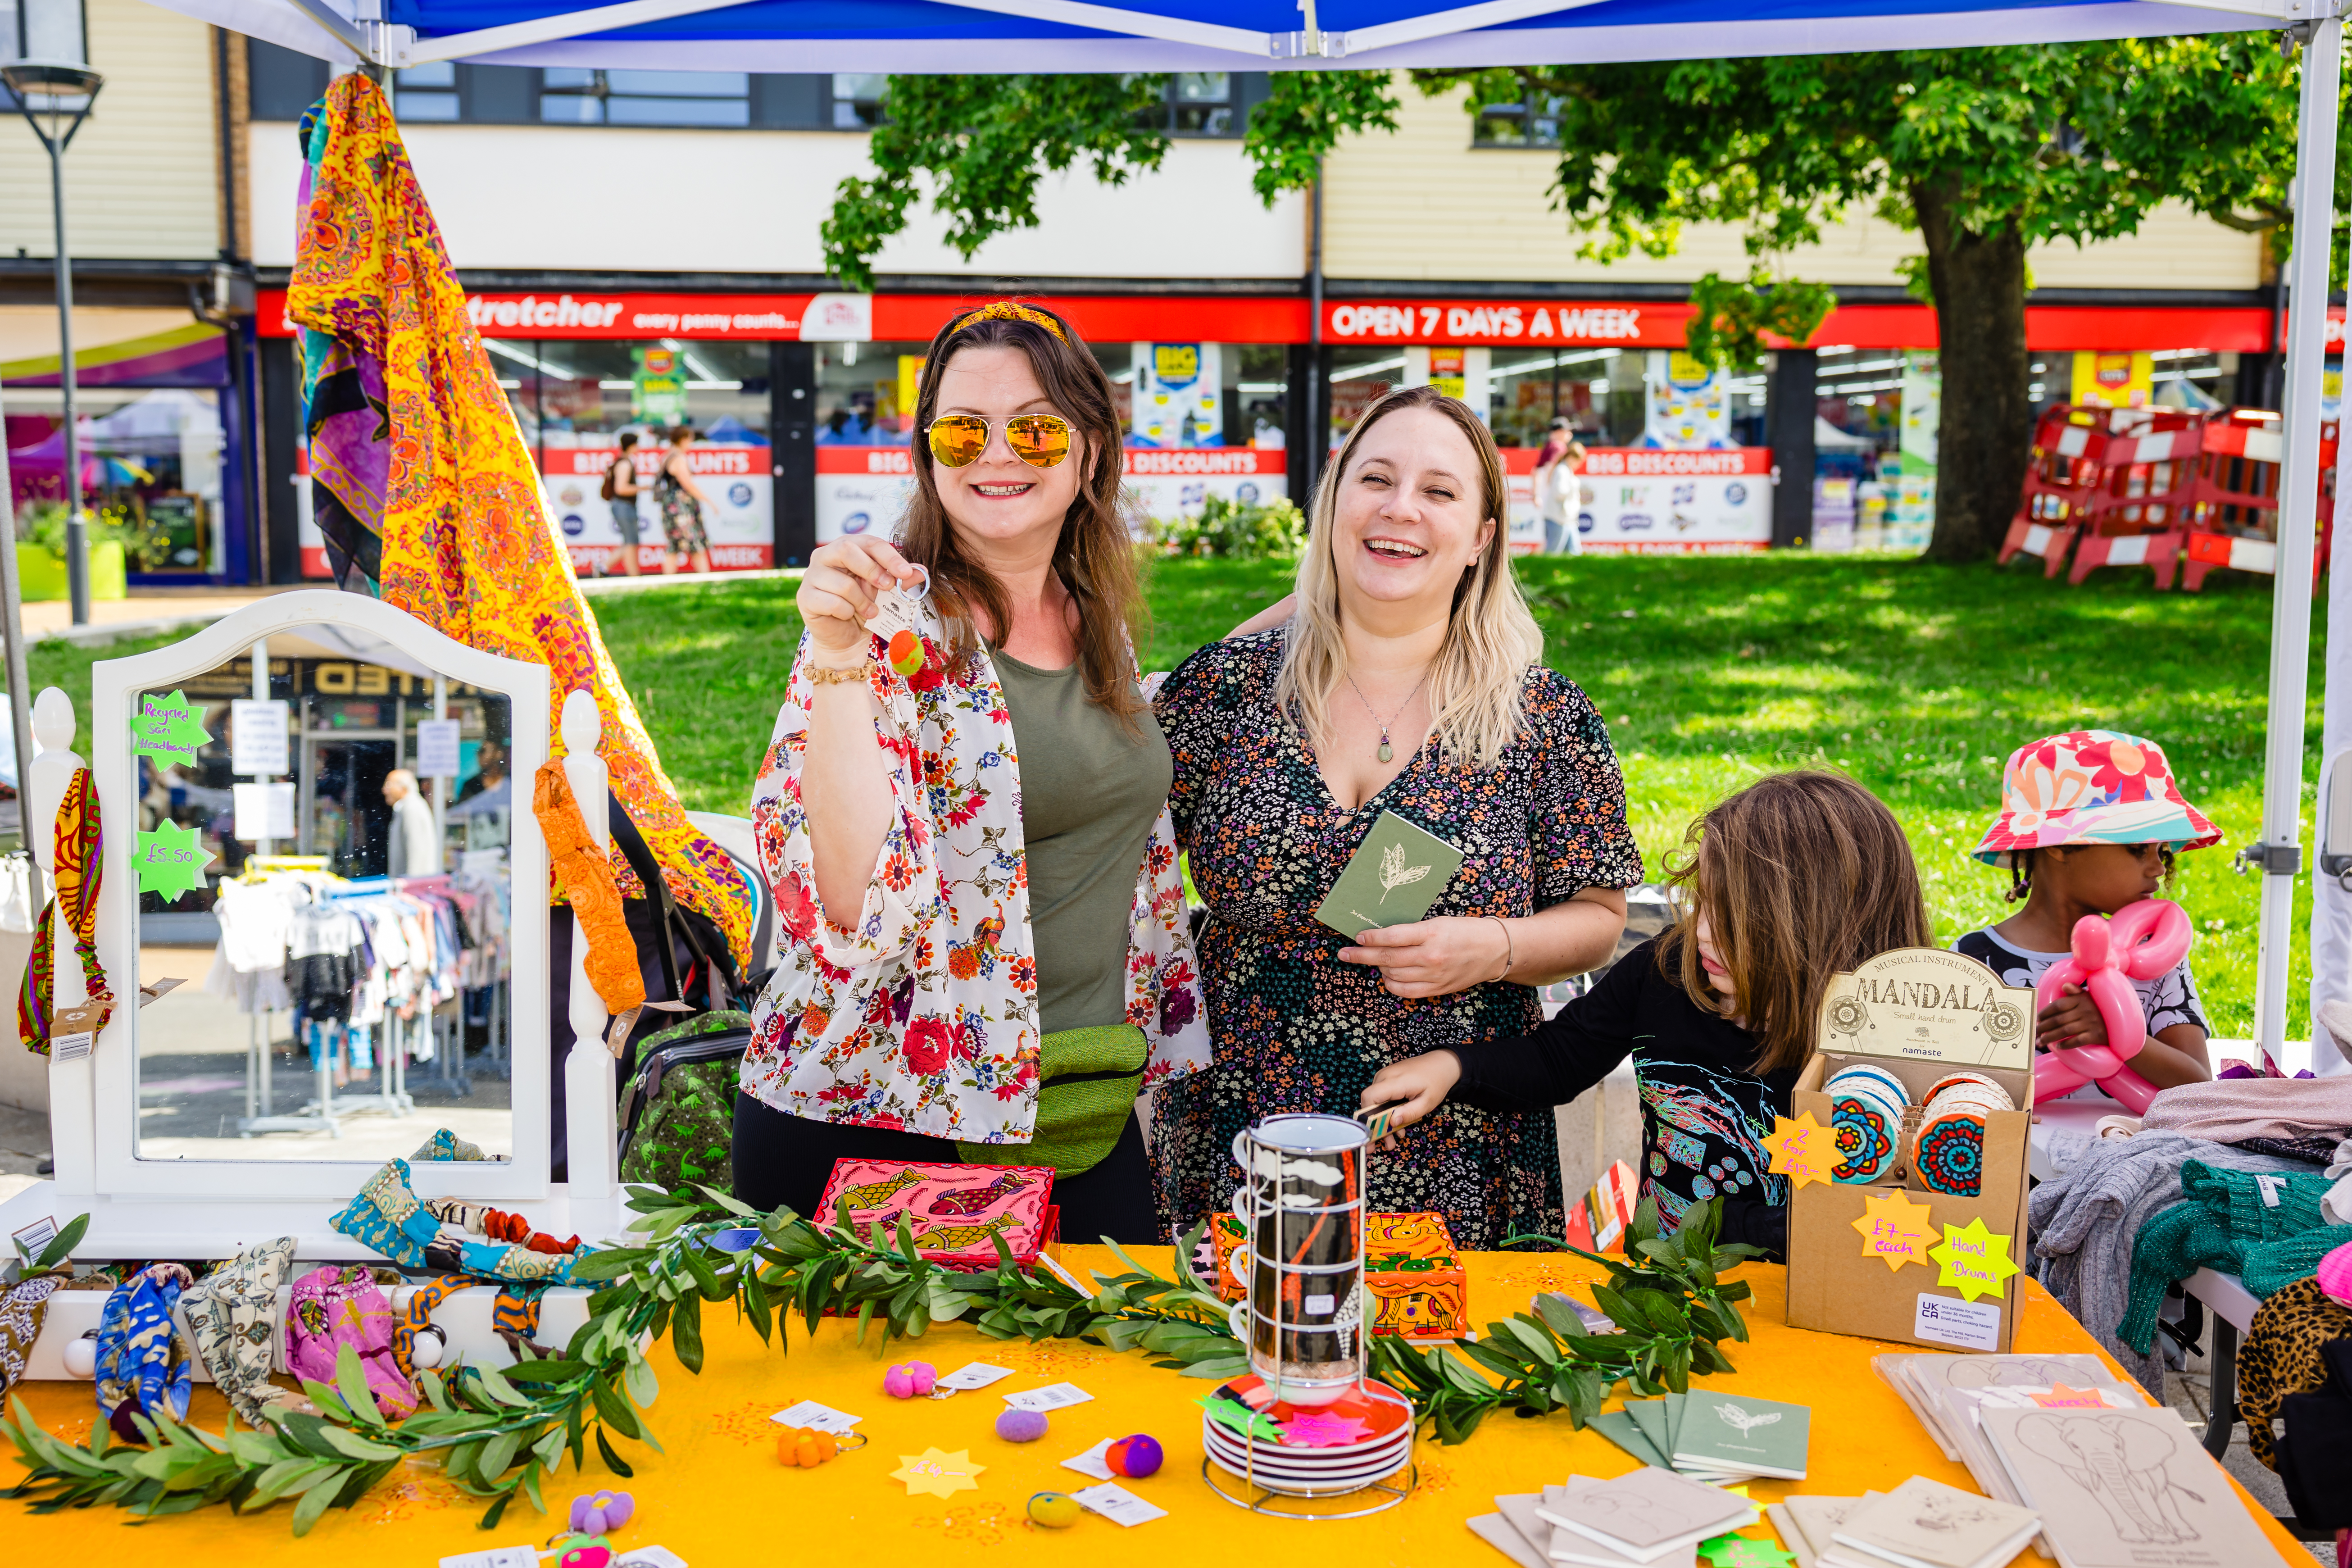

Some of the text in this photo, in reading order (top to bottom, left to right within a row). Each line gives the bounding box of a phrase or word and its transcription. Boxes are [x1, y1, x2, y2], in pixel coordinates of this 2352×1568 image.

[467, 295, 623, 327] tretcher
[1332, 305, 1640, 338] OPEN 7 DAYS A WEEK
[573, 452, 615, 474] BIG
[867, 451, 909, 473] BIG
[1133, 452, 1258, 474] DISCOUNTS
[1586, 453, 1745, 474] BIG DISCOUNTS
[638, 547, 689, 567] DAS
[710, 548, 763, 567] WEEK
[882, 604, 906, 623] namaste
[145, 703, 189, 725] Recycled
[147, 723, 171, 735] Sari
[139, 738, 195, 754] Headbands
[145, 843, 193, 863] £5.50
[1874, 955, 1990, 986] MUSICAL INSTRUMENT
[1854, 978, 1999, 1013] MANDALA
[1893, 1012, 1956, 1024] Small hand drum
[1902, 1048, 1942, 1056] namaste
[1797, 1129, 1810, 1145] 2
[1781, 1138, 1807, 1157] for
[2259, 1177, 2269, 1190] swee
[1875, 1240, 1913, 1255] each
[1952, 1236, 1985, 1257] Hand
[1952, 1261, 1997, 1282] Drums
[1922, 1309, 1939, 1319] CA
[1923, 1301, 1939, 1311] UK
